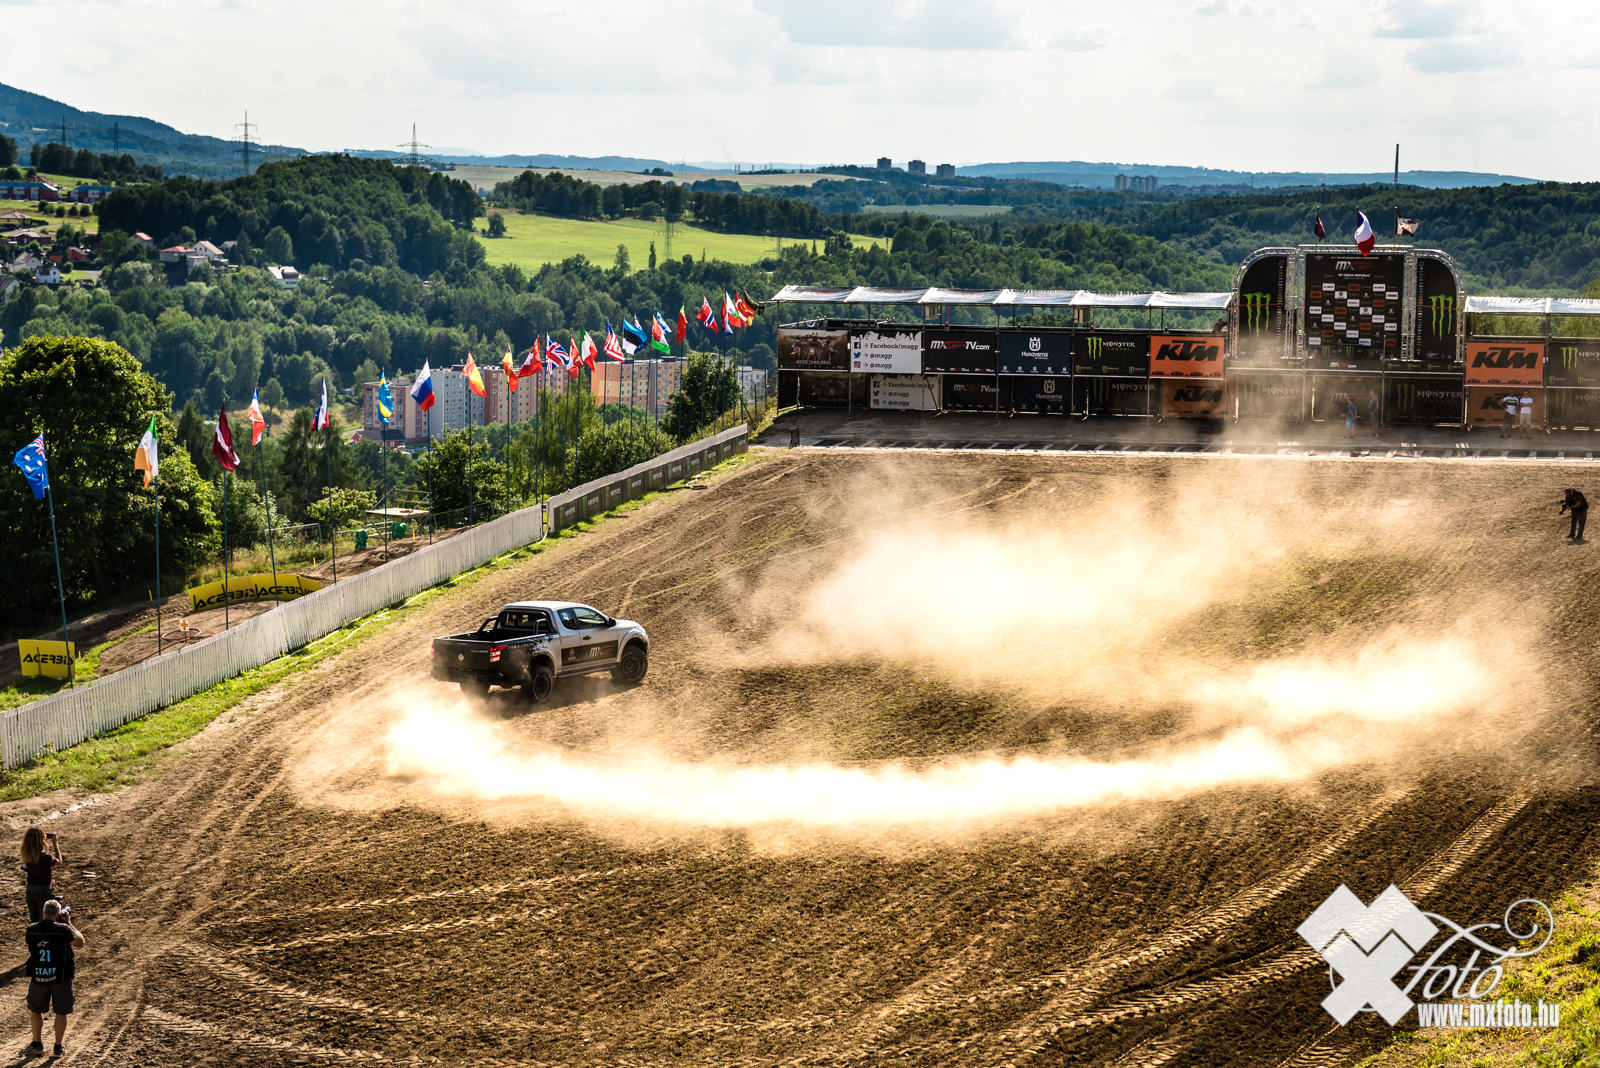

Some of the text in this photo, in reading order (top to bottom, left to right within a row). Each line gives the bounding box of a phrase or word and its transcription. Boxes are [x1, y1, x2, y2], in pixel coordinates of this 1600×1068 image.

[870, 342, 919, 350] Facebook/mxgp
[1102, 340, 1136, 348] MONSTER
[1155, 340, 1220, 361] KTM
[1471, 347, 1539, 369] KTM
[1111, 382, 1156, 391] MONSTER
[1173, 385, 1224, 402] KTM
[1417, 390, 1464, 399] MONSTER
[39, 949, 51, 962] 21
[35, 967, 57, 975] STAFF
